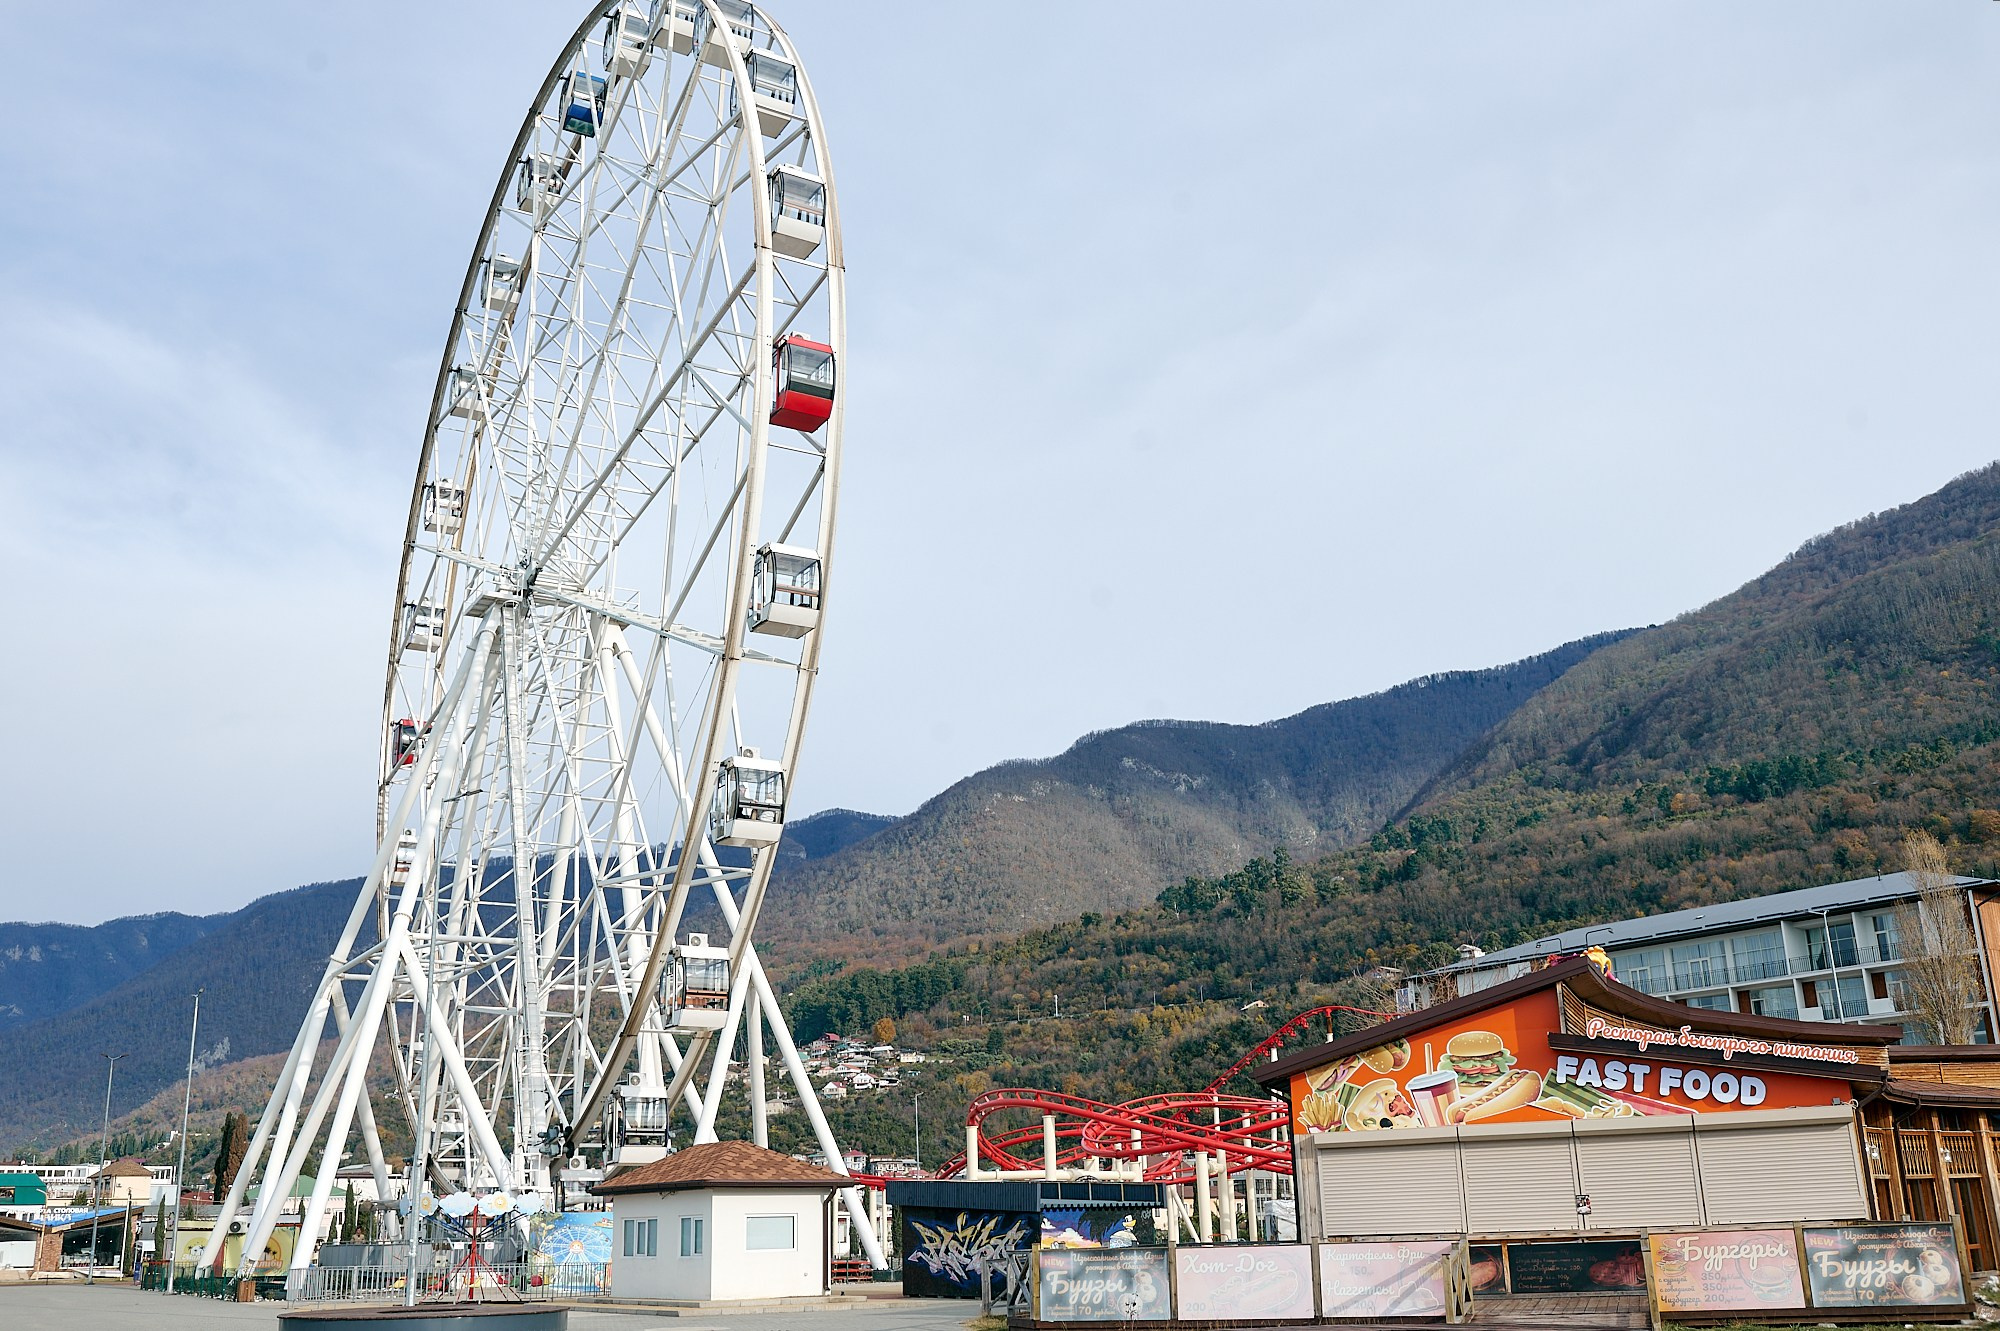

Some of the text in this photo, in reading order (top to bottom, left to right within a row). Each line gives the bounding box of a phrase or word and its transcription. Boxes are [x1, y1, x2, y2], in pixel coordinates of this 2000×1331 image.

[1586, 1017, 1859, 1064] Ресторан быстрого питания
[1555, 1055, 1767, 1106] FAST FOOD
[1899, 1228, 1928, 1242] блюда
[1928, 1227, 1952, 1242] Азии
[1809, 1237, 1834, 1247] NEW
[1857, 1243, 1896, 1253] доступны
[1324, 1245, 1425, 1266] Картофель Фри
[1676, 1236, 1789, 1272] Бургеры
[1044, 1259, 1065, 1267] NEW
[1183, 1253, 1278, 1274] Хот-Дог
[1812, 1250, 1916, 1288] Буузы
[1701, 1272, 1721, 1281] 350
[1046, 1270, 1127, 1305] Буузы
[1324, 1280, 1395, 1296] Наггетсы
[1702, 1283, 1722, 1292] 350
[1660, 1294, 1700, 1307] Чизбургер
[1704, 1294, 1725, 1303] 200
[1858, 1290, 1875, 1300] 70
[1078, 1306, 1092, 1315] 70
[1185, 1302, 1206, 1312] 200
